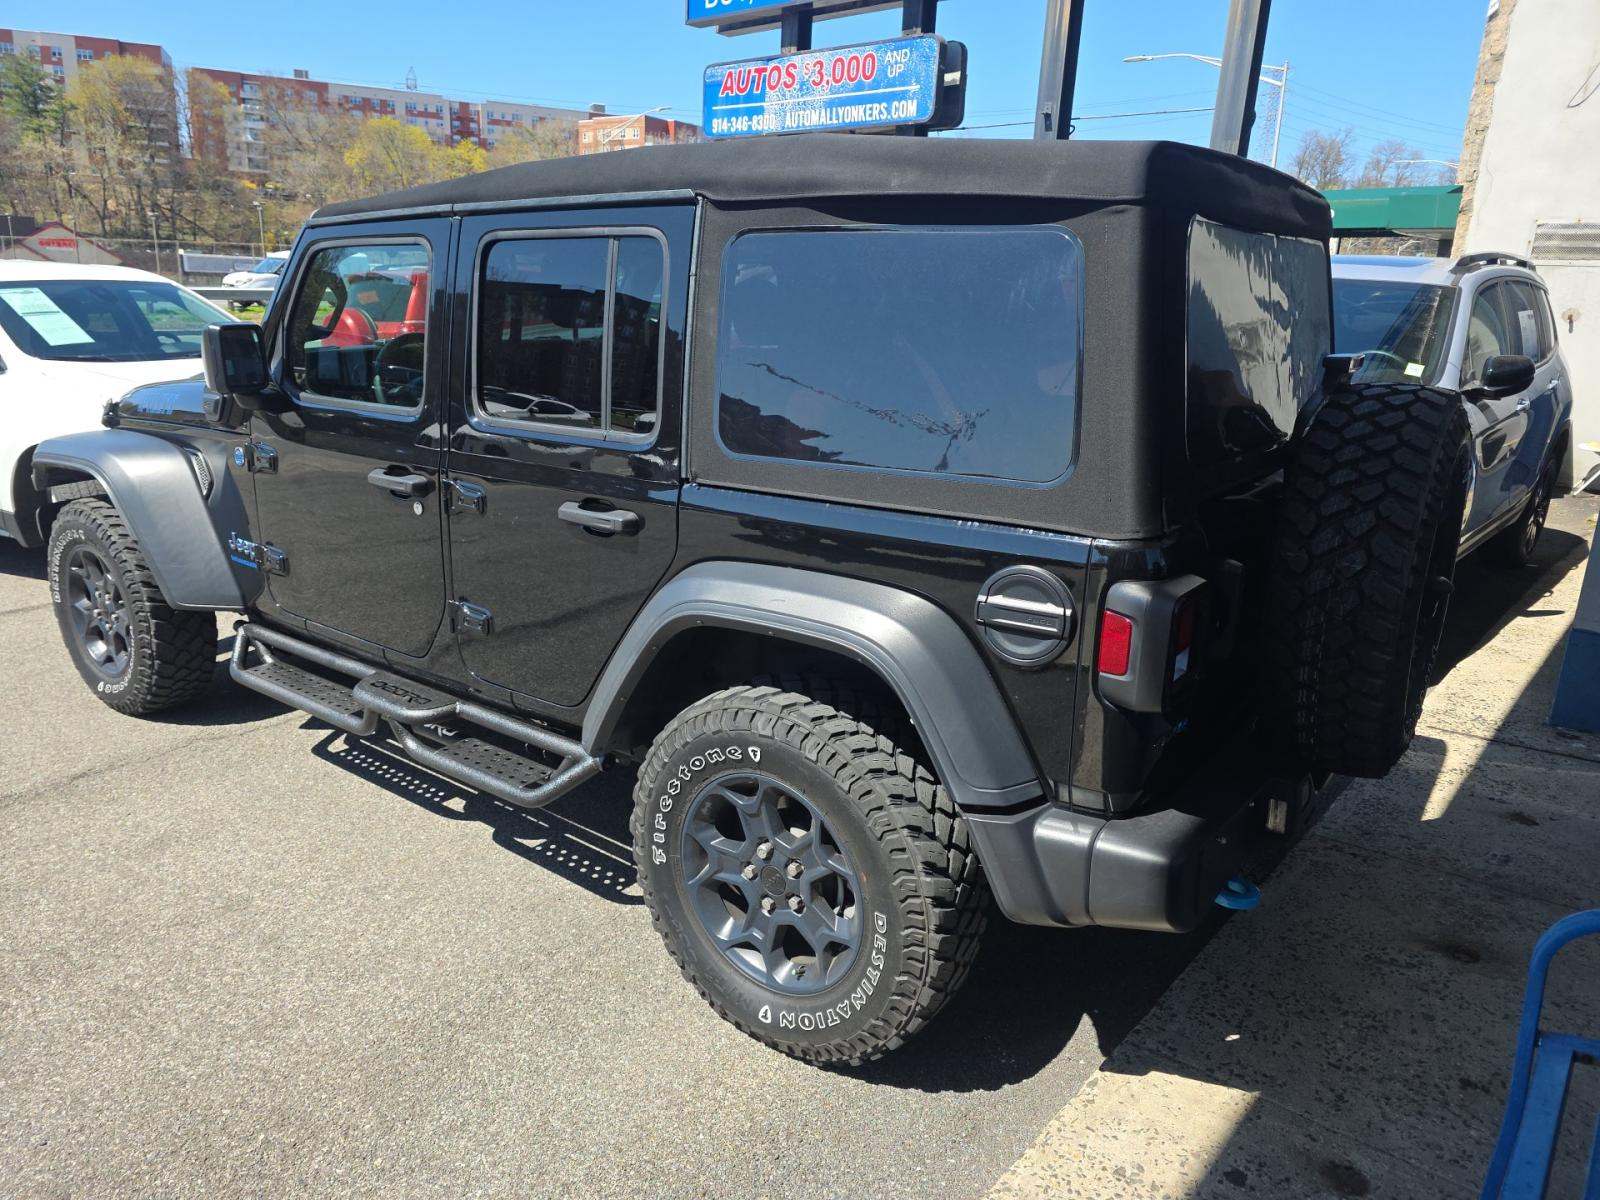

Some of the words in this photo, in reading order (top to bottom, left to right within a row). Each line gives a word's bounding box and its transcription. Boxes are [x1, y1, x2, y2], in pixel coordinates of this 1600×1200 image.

[885, 49, 910, 64] AND
[888, 64, 904, 78] UP
[719, 61, 798, 97] AUTOS
[785, 100, 918, 129] AUTOMALLYONKERS.COM
[652, 746, 742, 865] Firestone
[779, 911, 888, 1031] DESTINATION
